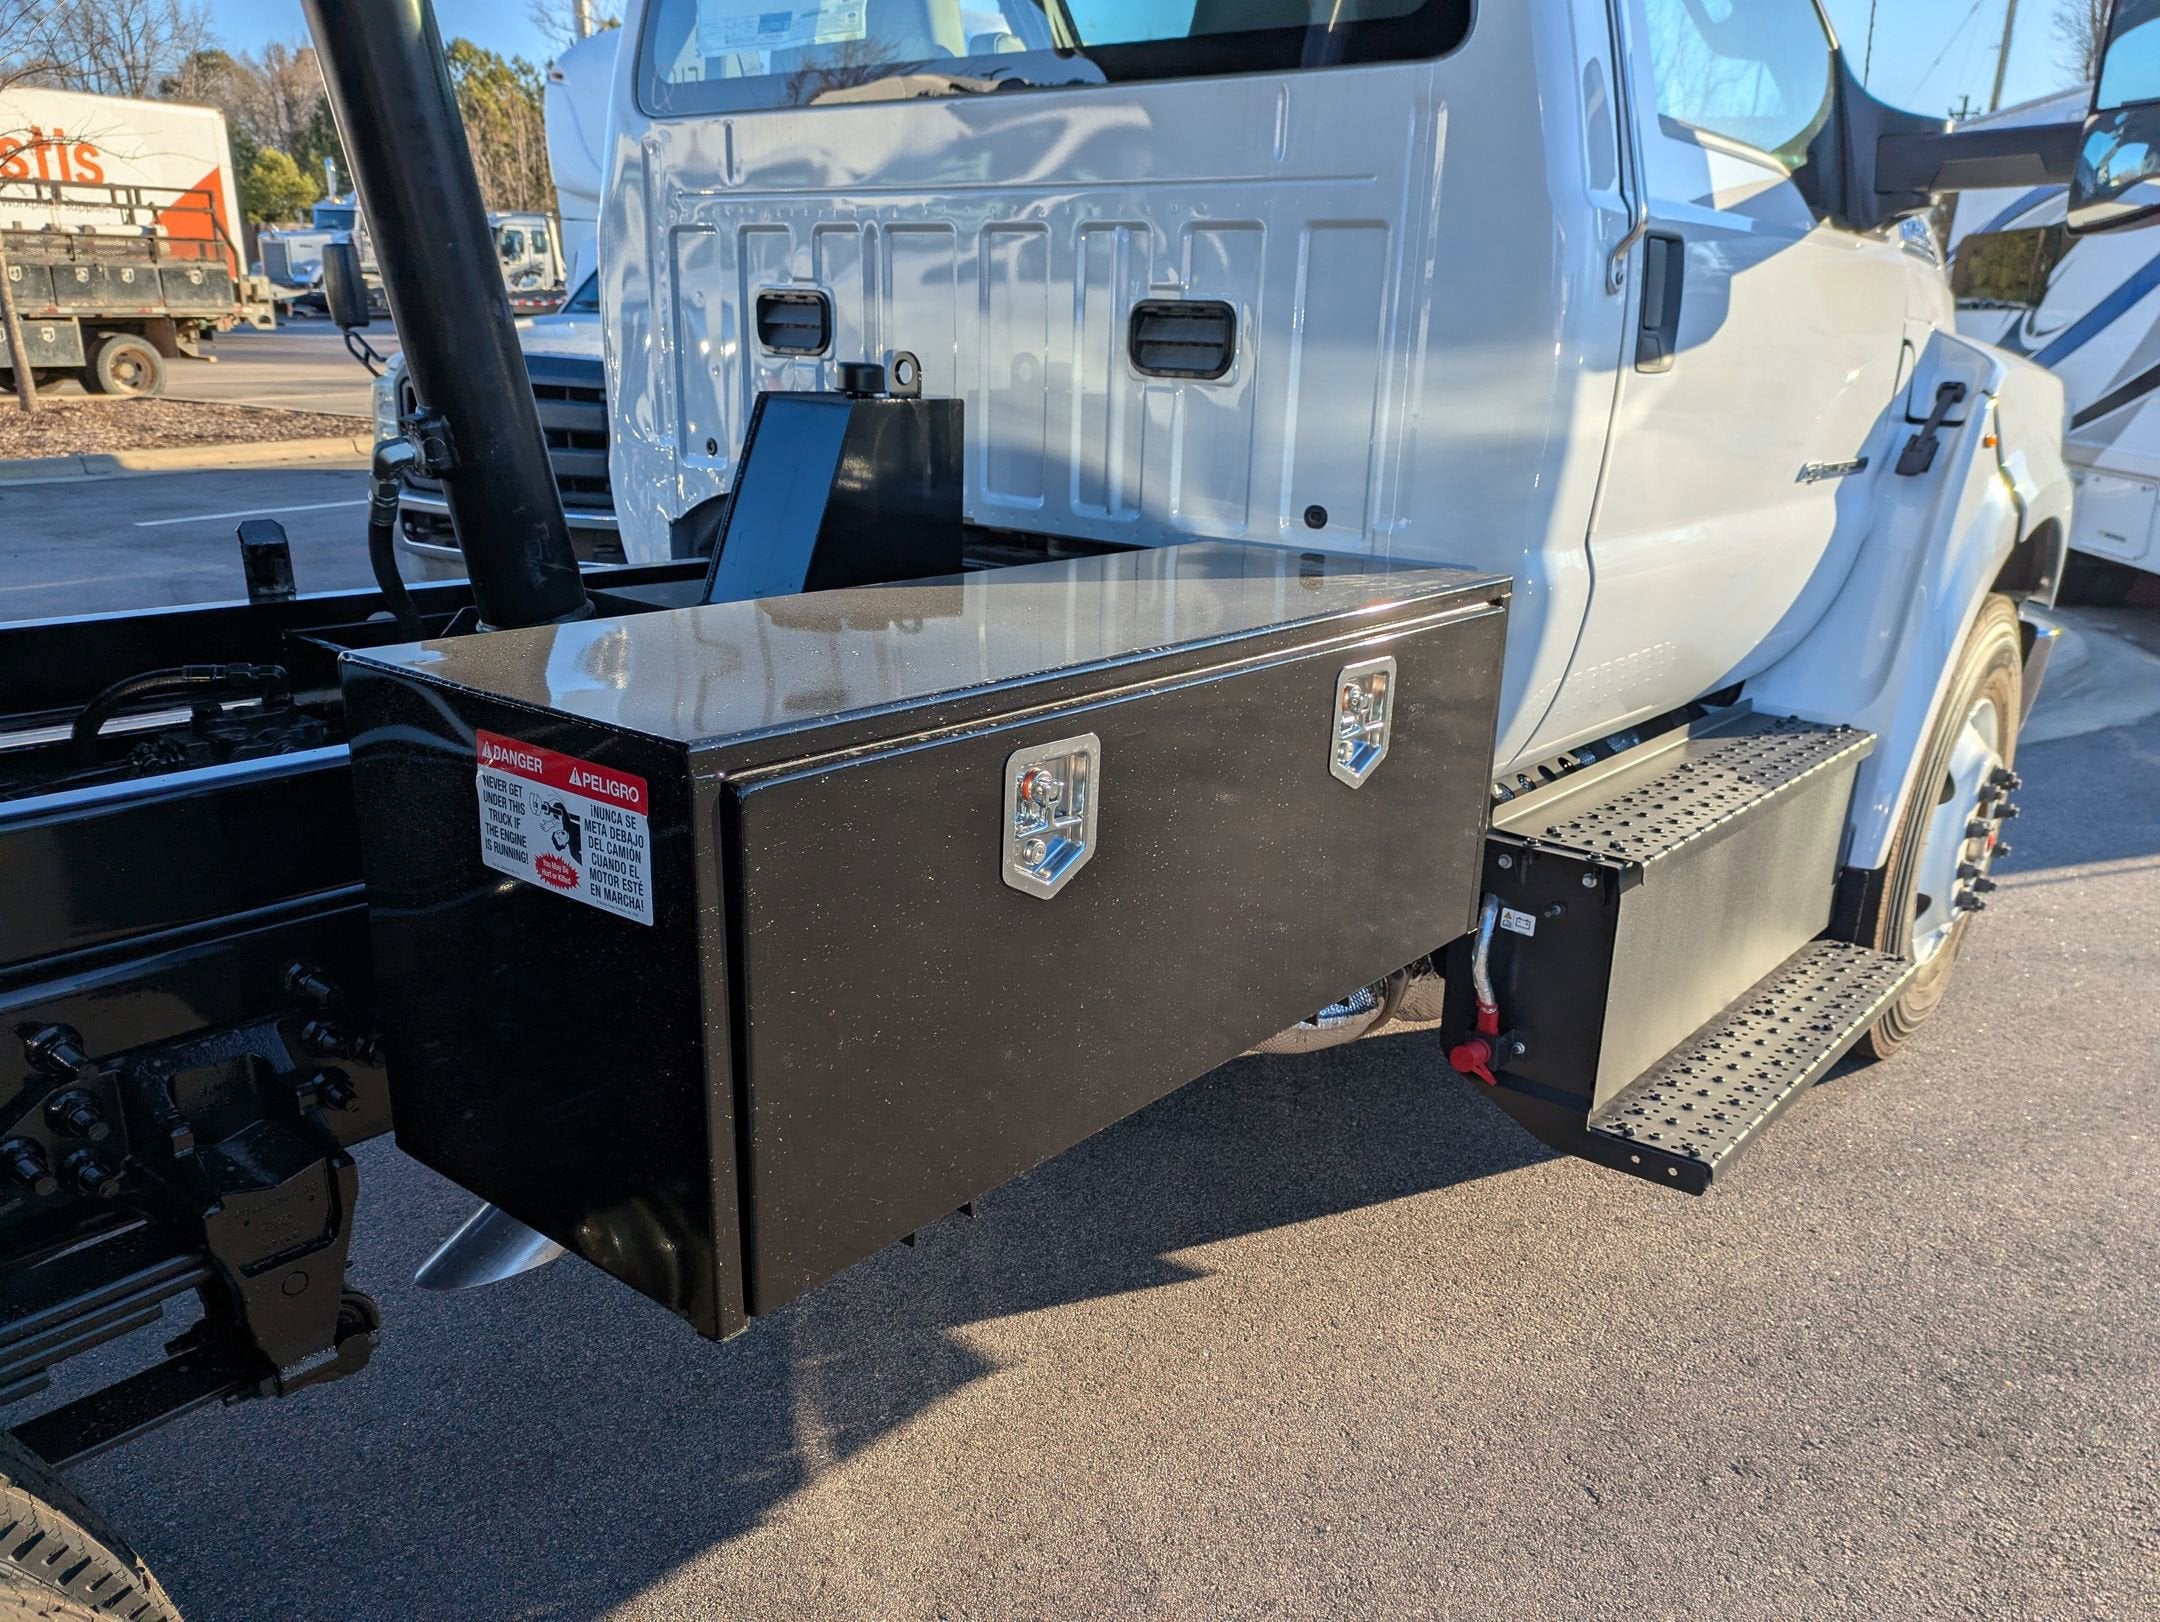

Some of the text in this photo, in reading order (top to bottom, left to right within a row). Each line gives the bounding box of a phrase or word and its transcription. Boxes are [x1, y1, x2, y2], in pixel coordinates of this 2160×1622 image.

[493, 745, 543, 774] DANGER
[482, 774, 523, 798] NEVER GET
[582, 772, 639, 803] PELIGRO
[483, 789, 526, 816] UNDER THIS
[489, 807, 521, 830] TRUCK IF
[590, 804, 637, 830] ¡NUNCA SE
[484, 822, 527, 848] THE ENGINE
[584, 818, 644, 849] META DEBAJO
[485, 837, 529, 865] IS RUNNING!
[542, 858, 551, 868] You
[588, 835, 642, 864] DEL CAMIÓN
[591, 852, 640, 880] CUANDO EL
[589, 867, 644, 897] MOTOR ESTÉ
[590, 883, 601, 899] EN
[604, 886, 644, 912] MARCHA!
